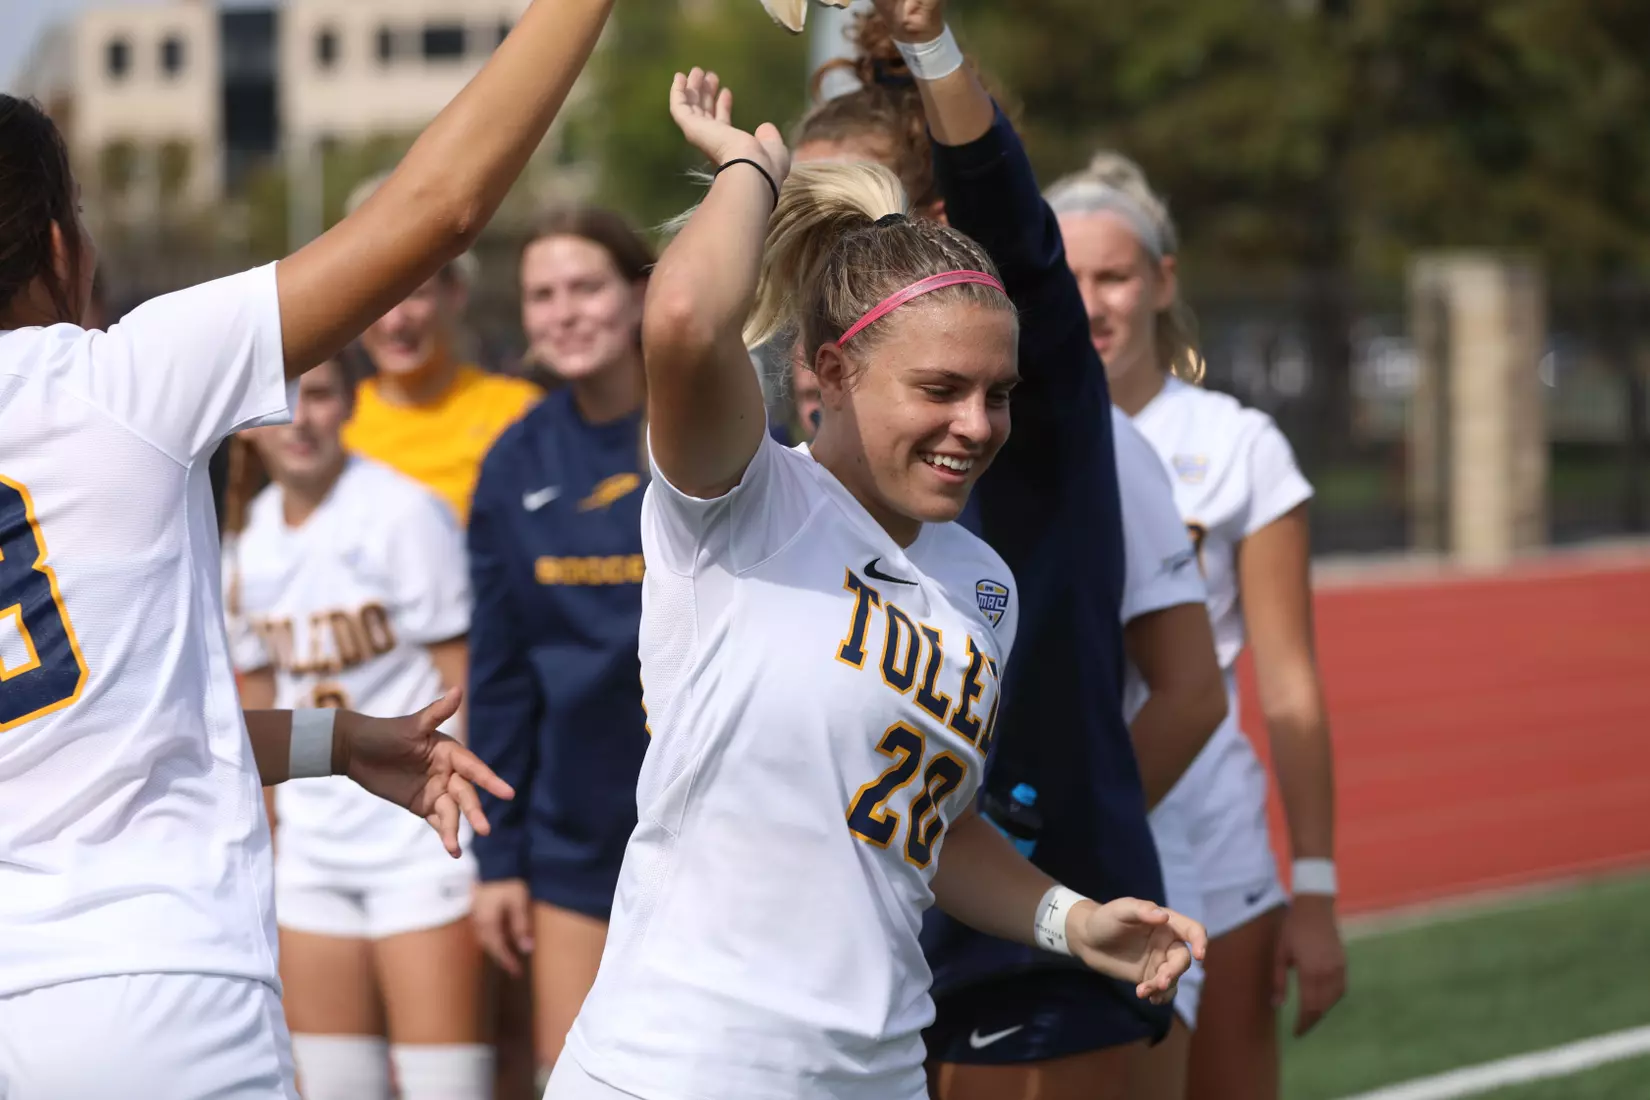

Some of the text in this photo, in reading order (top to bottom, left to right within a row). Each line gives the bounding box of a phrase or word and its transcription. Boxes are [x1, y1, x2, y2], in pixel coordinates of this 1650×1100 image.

[835, 566, 999, 758] TOLE
[978, 594, 1007, 610] MAC
[845, 720, 967, 870] 20
